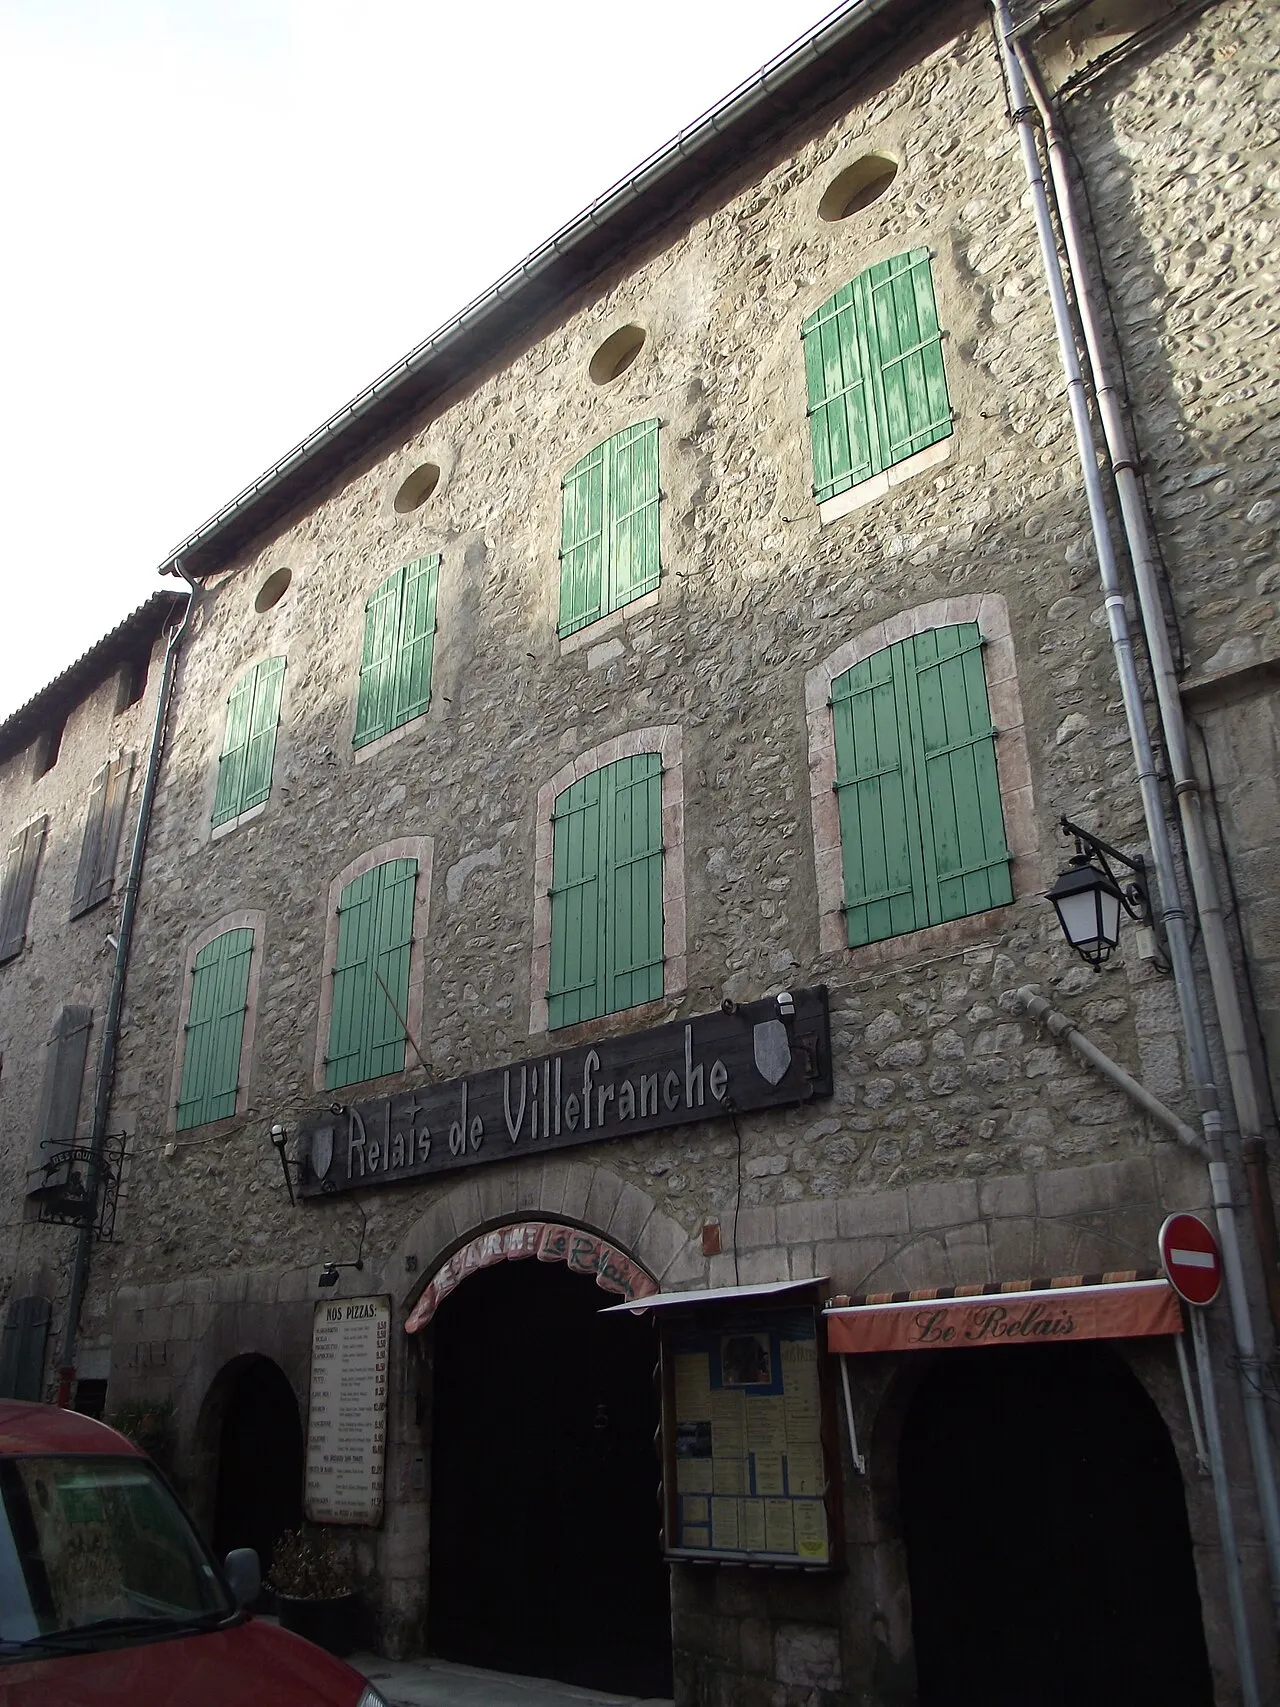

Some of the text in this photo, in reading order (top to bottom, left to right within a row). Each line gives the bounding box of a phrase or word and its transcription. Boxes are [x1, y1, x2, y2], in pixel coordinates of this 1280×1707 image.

[347, 1024, 730, 1179] Relais de Villefranche
[543, 1230, 567, 1256] Le
[326, 1304, 377, 1321] NOS PIZZAS:
[908, 1303, 1077, 1343] Le Relais
